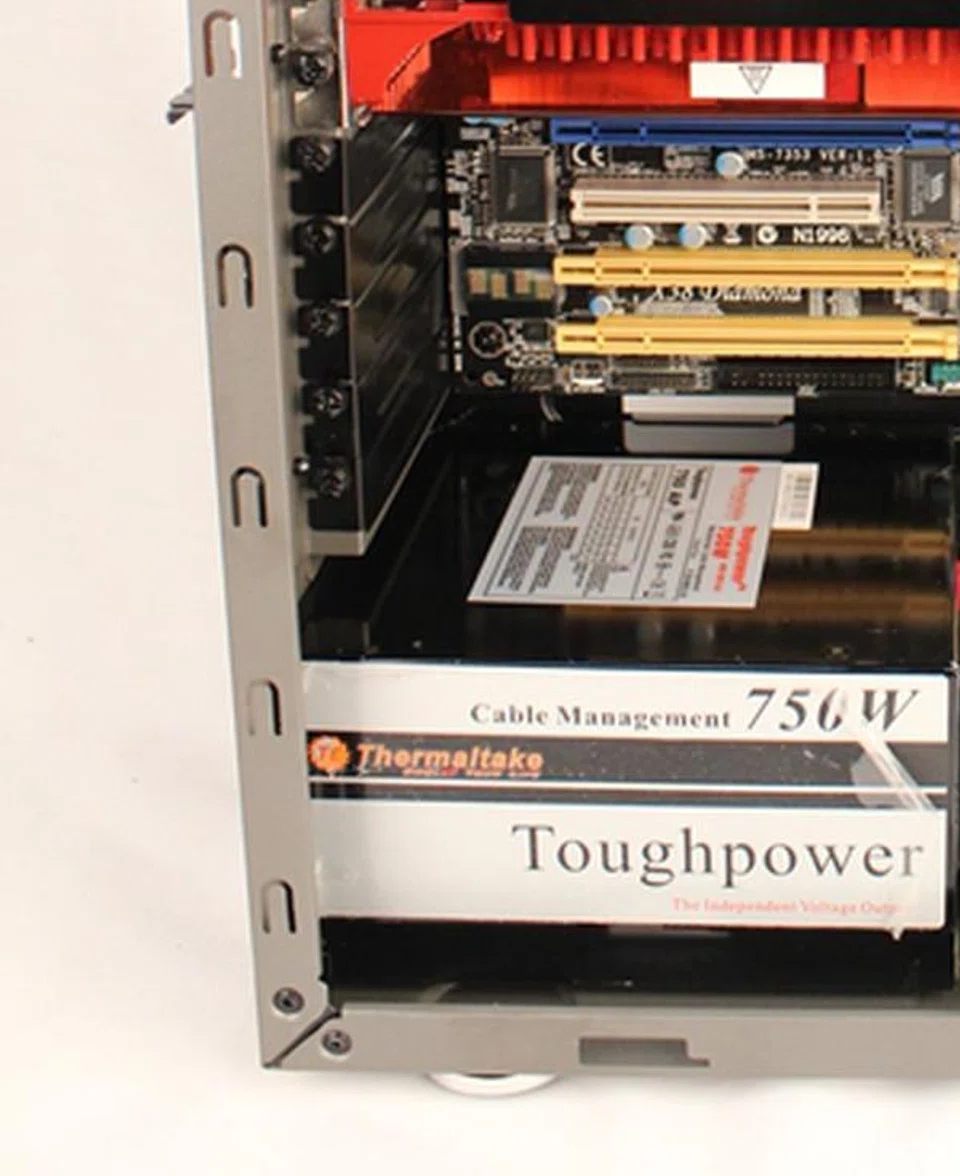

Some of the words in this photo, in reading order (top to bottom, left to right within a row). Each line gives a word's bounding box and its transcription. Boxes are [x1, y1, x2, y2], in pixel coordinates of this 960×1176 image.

[793, 226, 850, 244] N1996
[470, 702, 549, 726] Cable
[557, 705, 731, 731] Management
[356, 743, 544, 773] Thermaltake
[512, 824, 925, 889] Toughpower
[673, 898, 699, 912] The
[703, 898, 796, 914] Independent
[799, 899, 857, 916] Voltage
